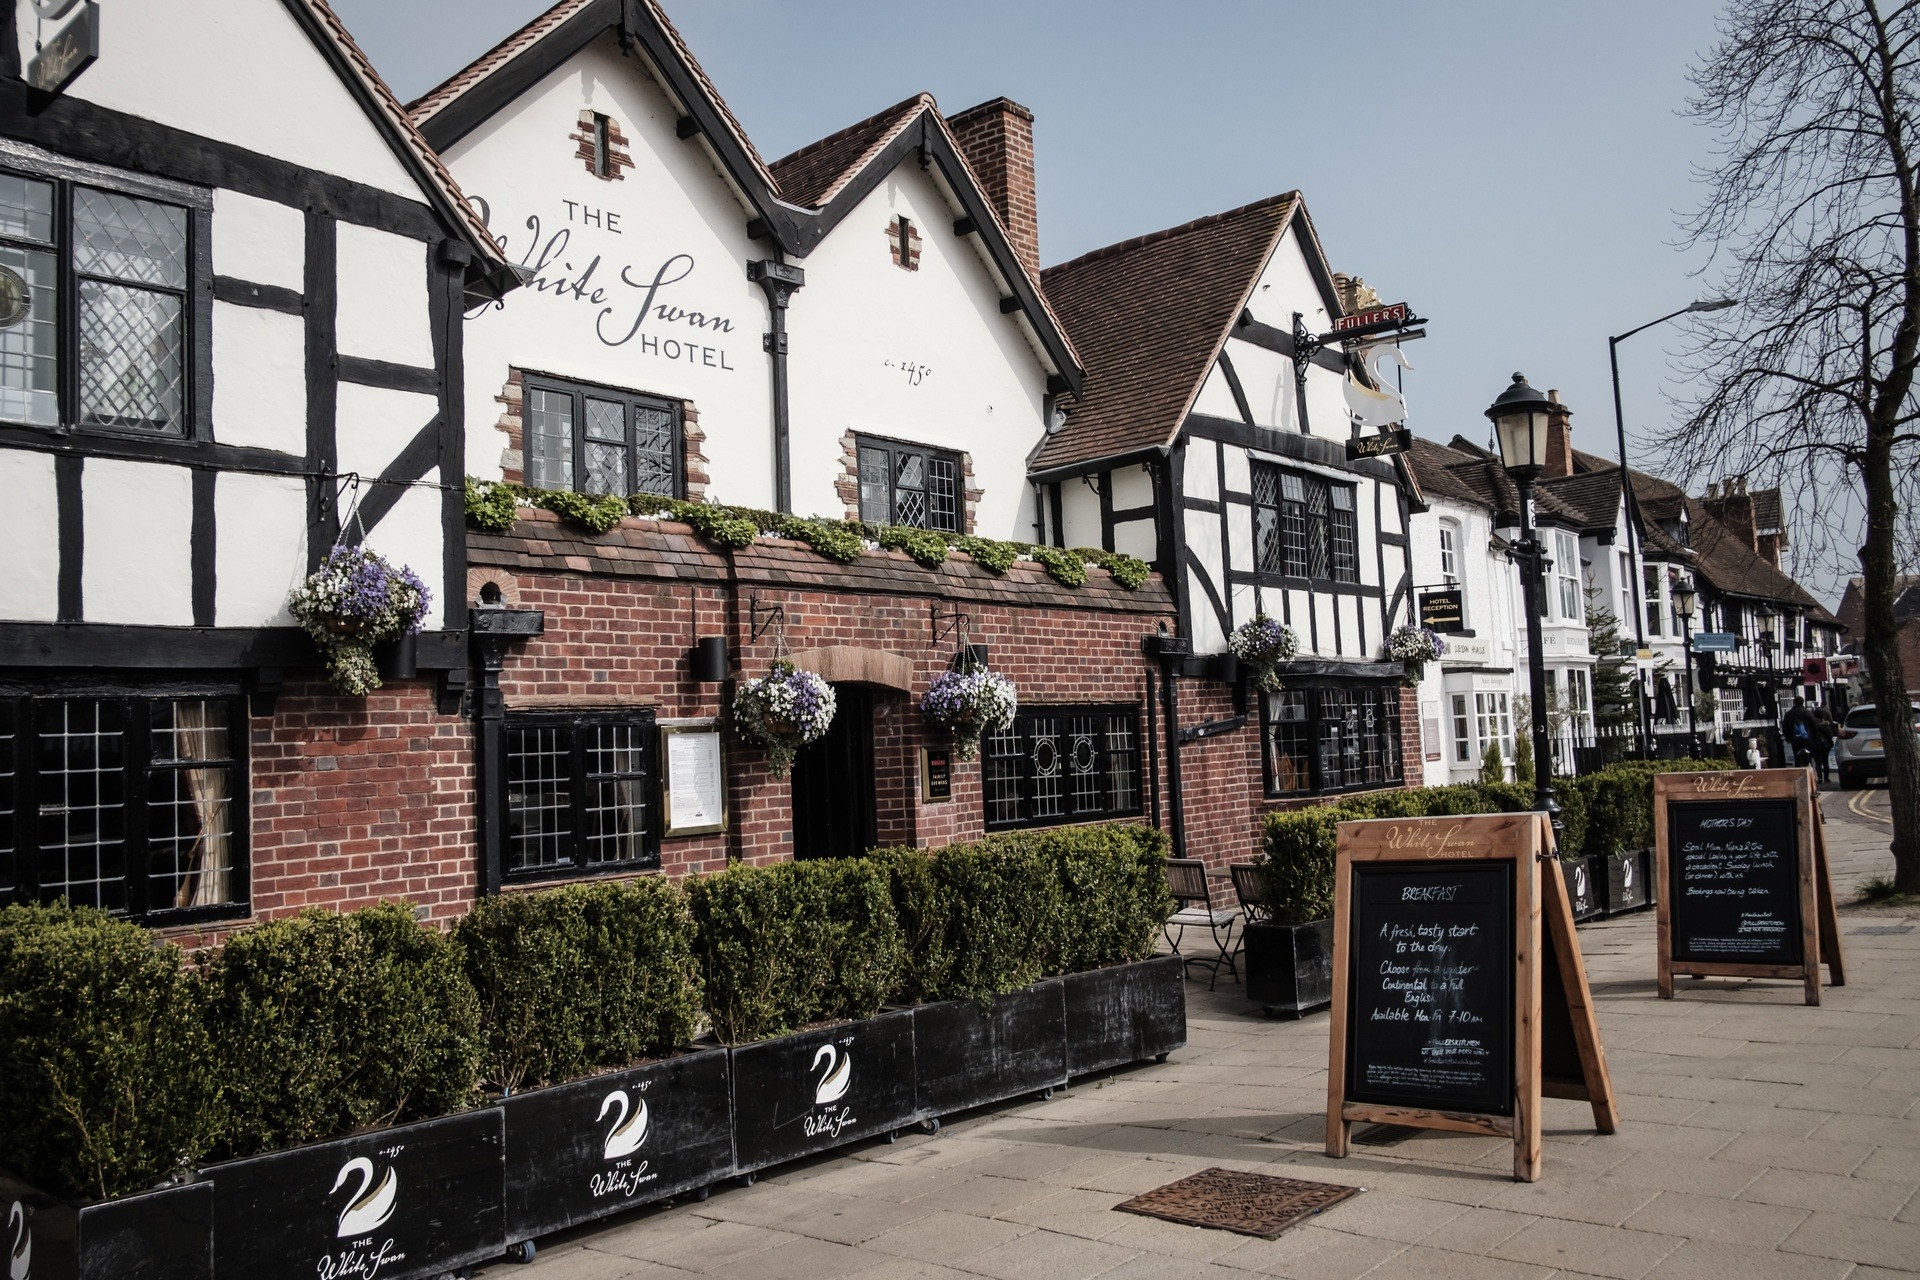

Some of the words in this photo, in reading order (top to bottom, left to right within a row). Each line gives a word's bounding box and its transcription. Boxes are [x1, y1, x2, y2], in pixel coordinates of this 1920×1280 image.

[563, 199, 622, 235] THE
[596, 253, 735, 347] Swan
[1337, 308, 1401, 331] FULLER'S
[641, 334, 734, 372] HOTEL
[900, 361, 932, 386] 1450
[1356, 441, 1380, 454] White
[1376, 437, 1398, 456] Swan
[1543, 633, 1556, 645] FÉ
[1693, 776, 1731, 792] White
[1726, 775, 1764, 799] Swan
[1386, 826, 1432, 849] White
[1426, 824, 1476, 859] Swan
[1401, 885, 1462, 901] BREAKFAST
[1380, 922, 1388, 937] A
[1418, 923, 1445, 942] tasty
[1448, 922, 1480, 937] start
[1396, 940, 1408, 953] to
[1410, 941, 1425, 952] the
[1380, 960, 1410, 975] Choose
[1382, 977, 1428, 990] Continental
[1404, 991, 1436, 1008] English
[1370, 1007, 1410, 1021] Available
[824, 1105, 838, 1113] THE
[803, 1114, 834, 1137] White
[831, 1106, 857, 1138] Swan
[615, 1159, 632, 1169] THE
[590, 1170, 629, 1197] White
[625, 1160, 659, 1197] Swan
[351, 1237, 373, 1249] THE
[317, 1250, 366, 1280] White
[362, 1238, 407, 1280] Swan
